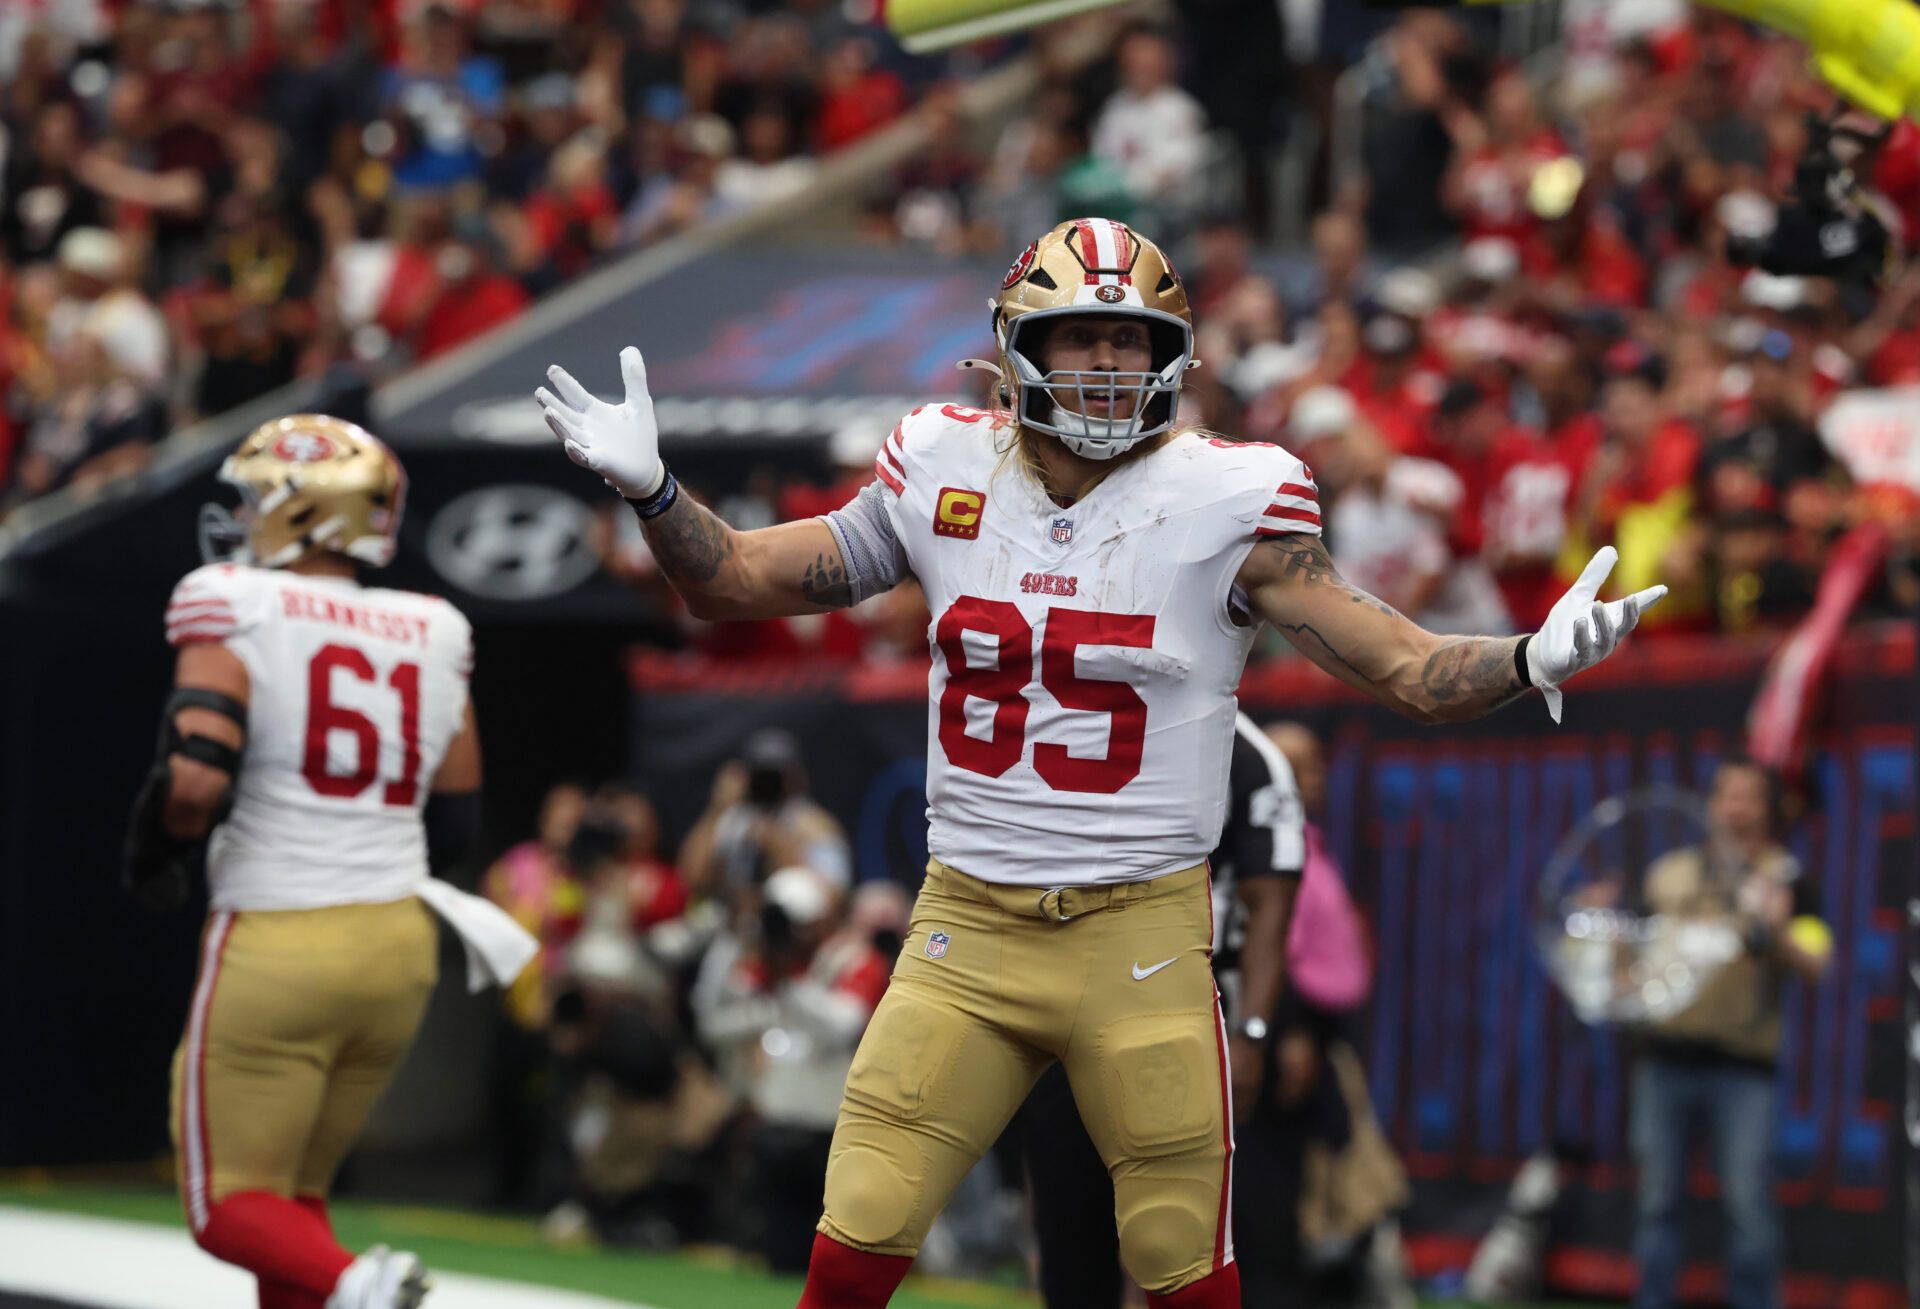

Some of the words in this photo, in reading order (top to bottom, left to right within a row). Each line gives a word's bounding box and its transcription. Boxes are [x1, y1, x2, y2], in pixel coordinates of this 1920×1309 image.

[938, 491, 980, 526] C
[1051, 528, 1072, 542] NFL
[1019, 572, 1078, 597] 49ERS
[281, 589, 430, 646] HENNESSY
[936, 594, 1156, 794] 85
[302, 643, 421, 807] 61
